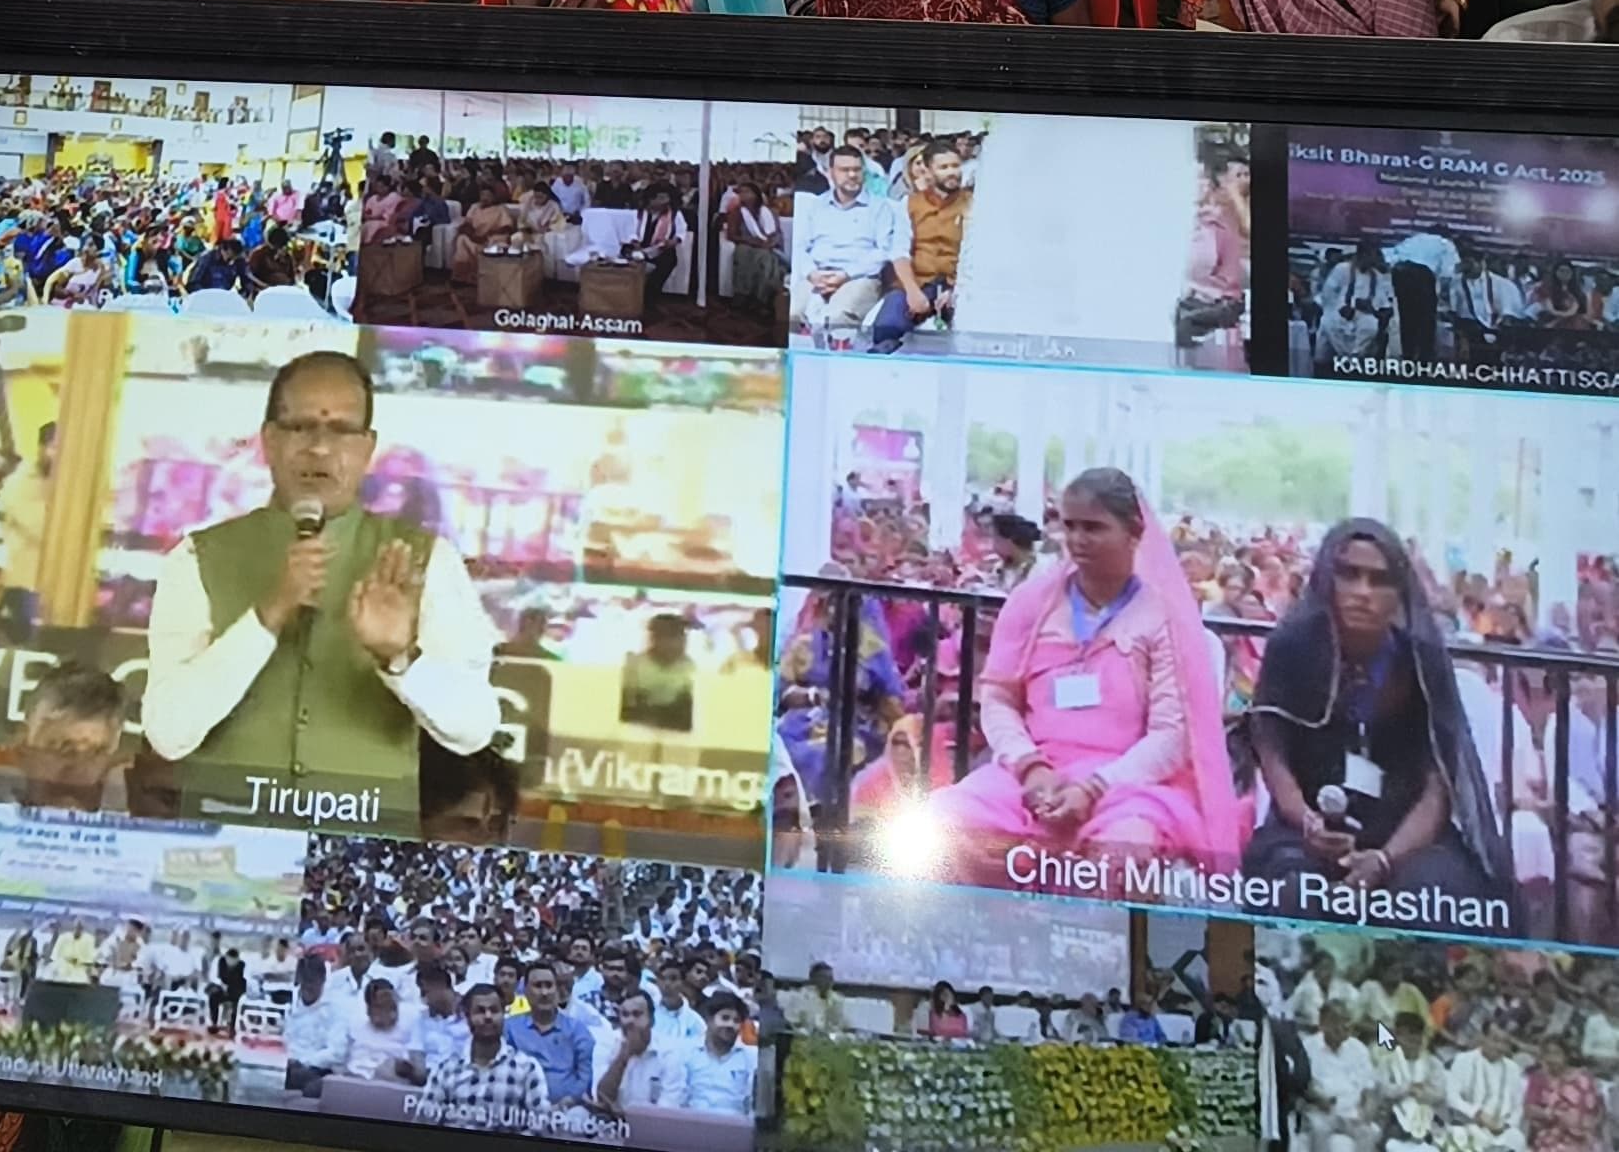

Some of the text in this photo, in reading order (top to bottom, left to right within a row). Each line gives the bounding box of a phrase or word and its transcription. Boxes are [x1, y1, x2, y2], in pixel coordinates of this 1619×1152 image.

[1439, 155, 1488, 176] RAM
[245, 775, 381, 826] Tirupati
[1005, 844, 1511, 929] Chief Minister Rajasthan
